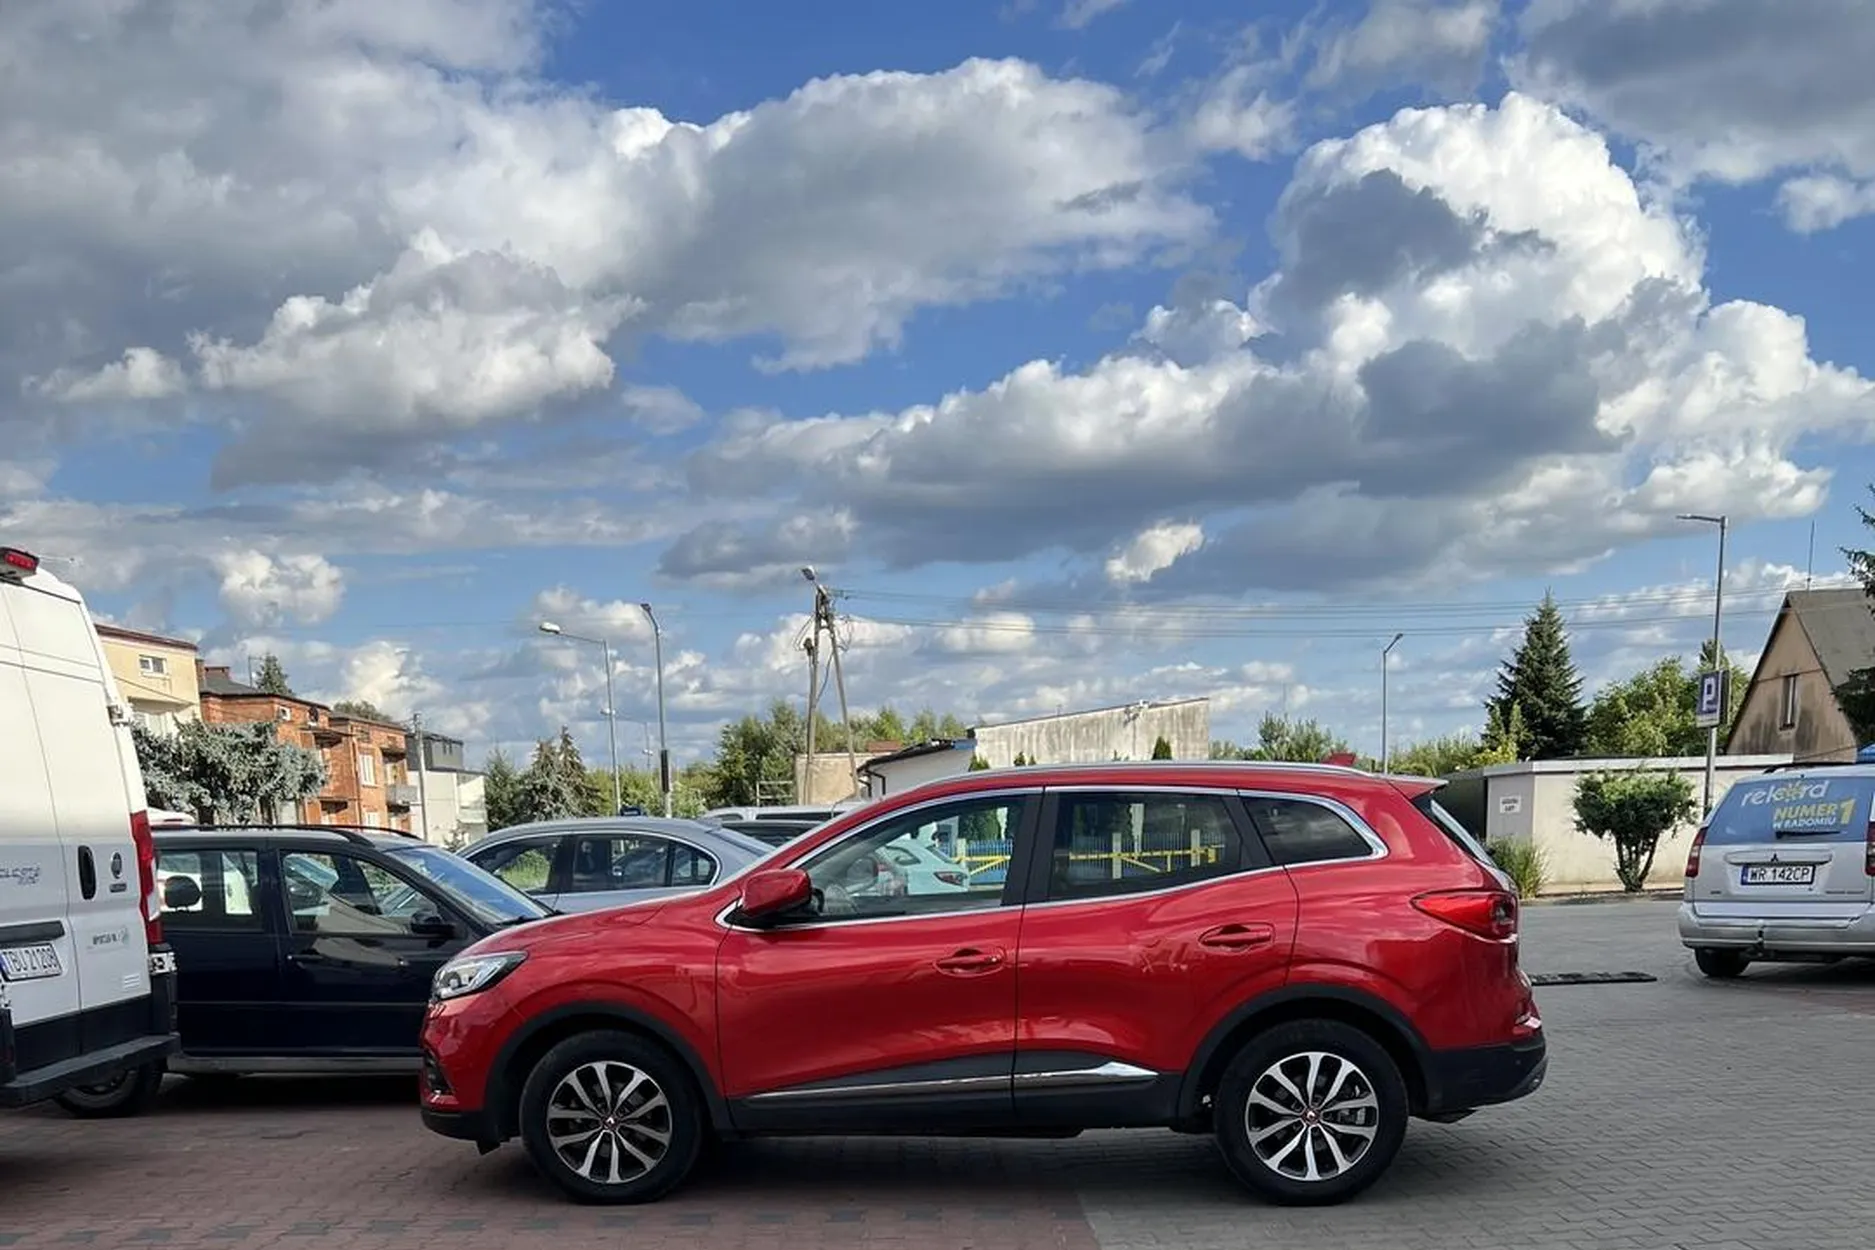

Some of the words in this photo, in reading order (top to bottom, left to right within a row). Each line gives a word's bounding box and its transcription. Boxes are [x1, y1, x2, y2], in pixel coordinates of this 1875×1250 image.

[1702, 677, 1716, 711] P
[1773, 803, 1838, 821] NUMER
[1840, 798, 1856, 825] 1
[1750, 867, 1766, 881] WR
[1771, 867, 1811, 881] 142CP
